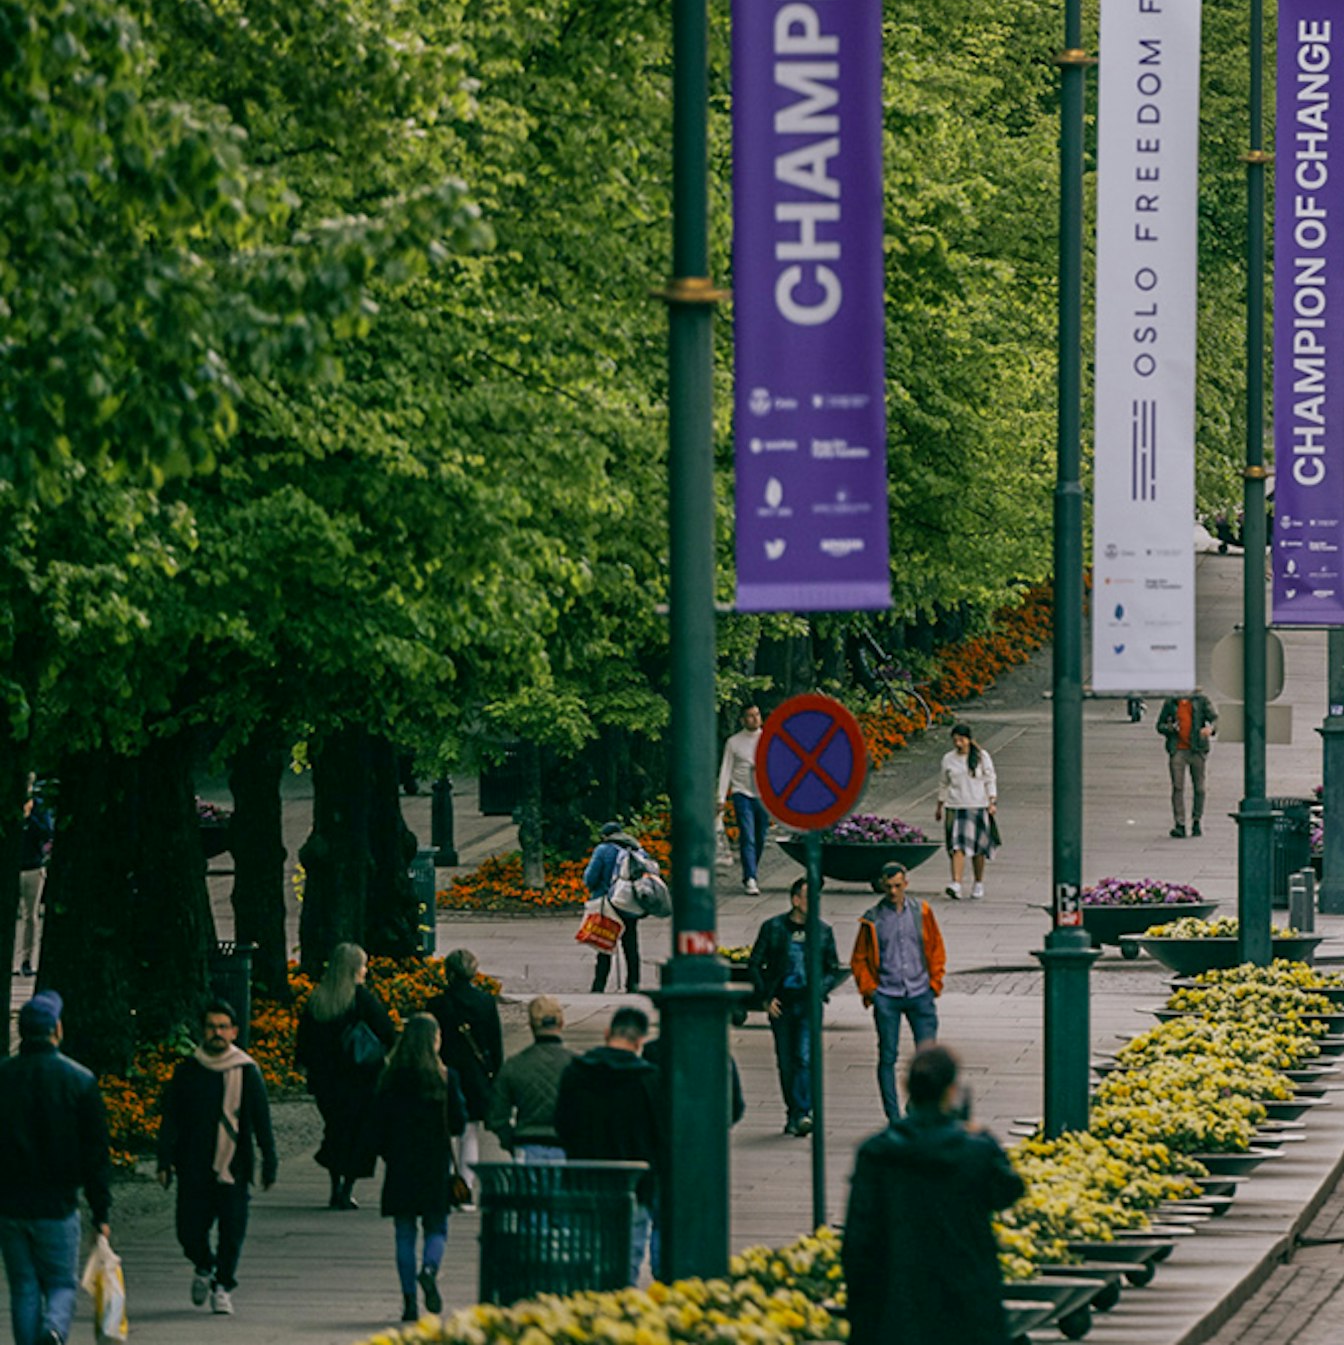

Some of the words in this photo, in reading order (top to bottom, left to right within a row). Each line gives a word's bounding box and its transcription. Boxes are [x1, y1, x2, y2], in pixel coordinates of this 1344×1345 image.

[1134, 39, 1162, 242] FREEDOM
[1295, 19, 1330, 190] CHANGE
[1294, 195, 1326, 250] OF
[1132, 266, 1158, 378] OSLO
[1292, 257, 1325, 486] CHAMPION
